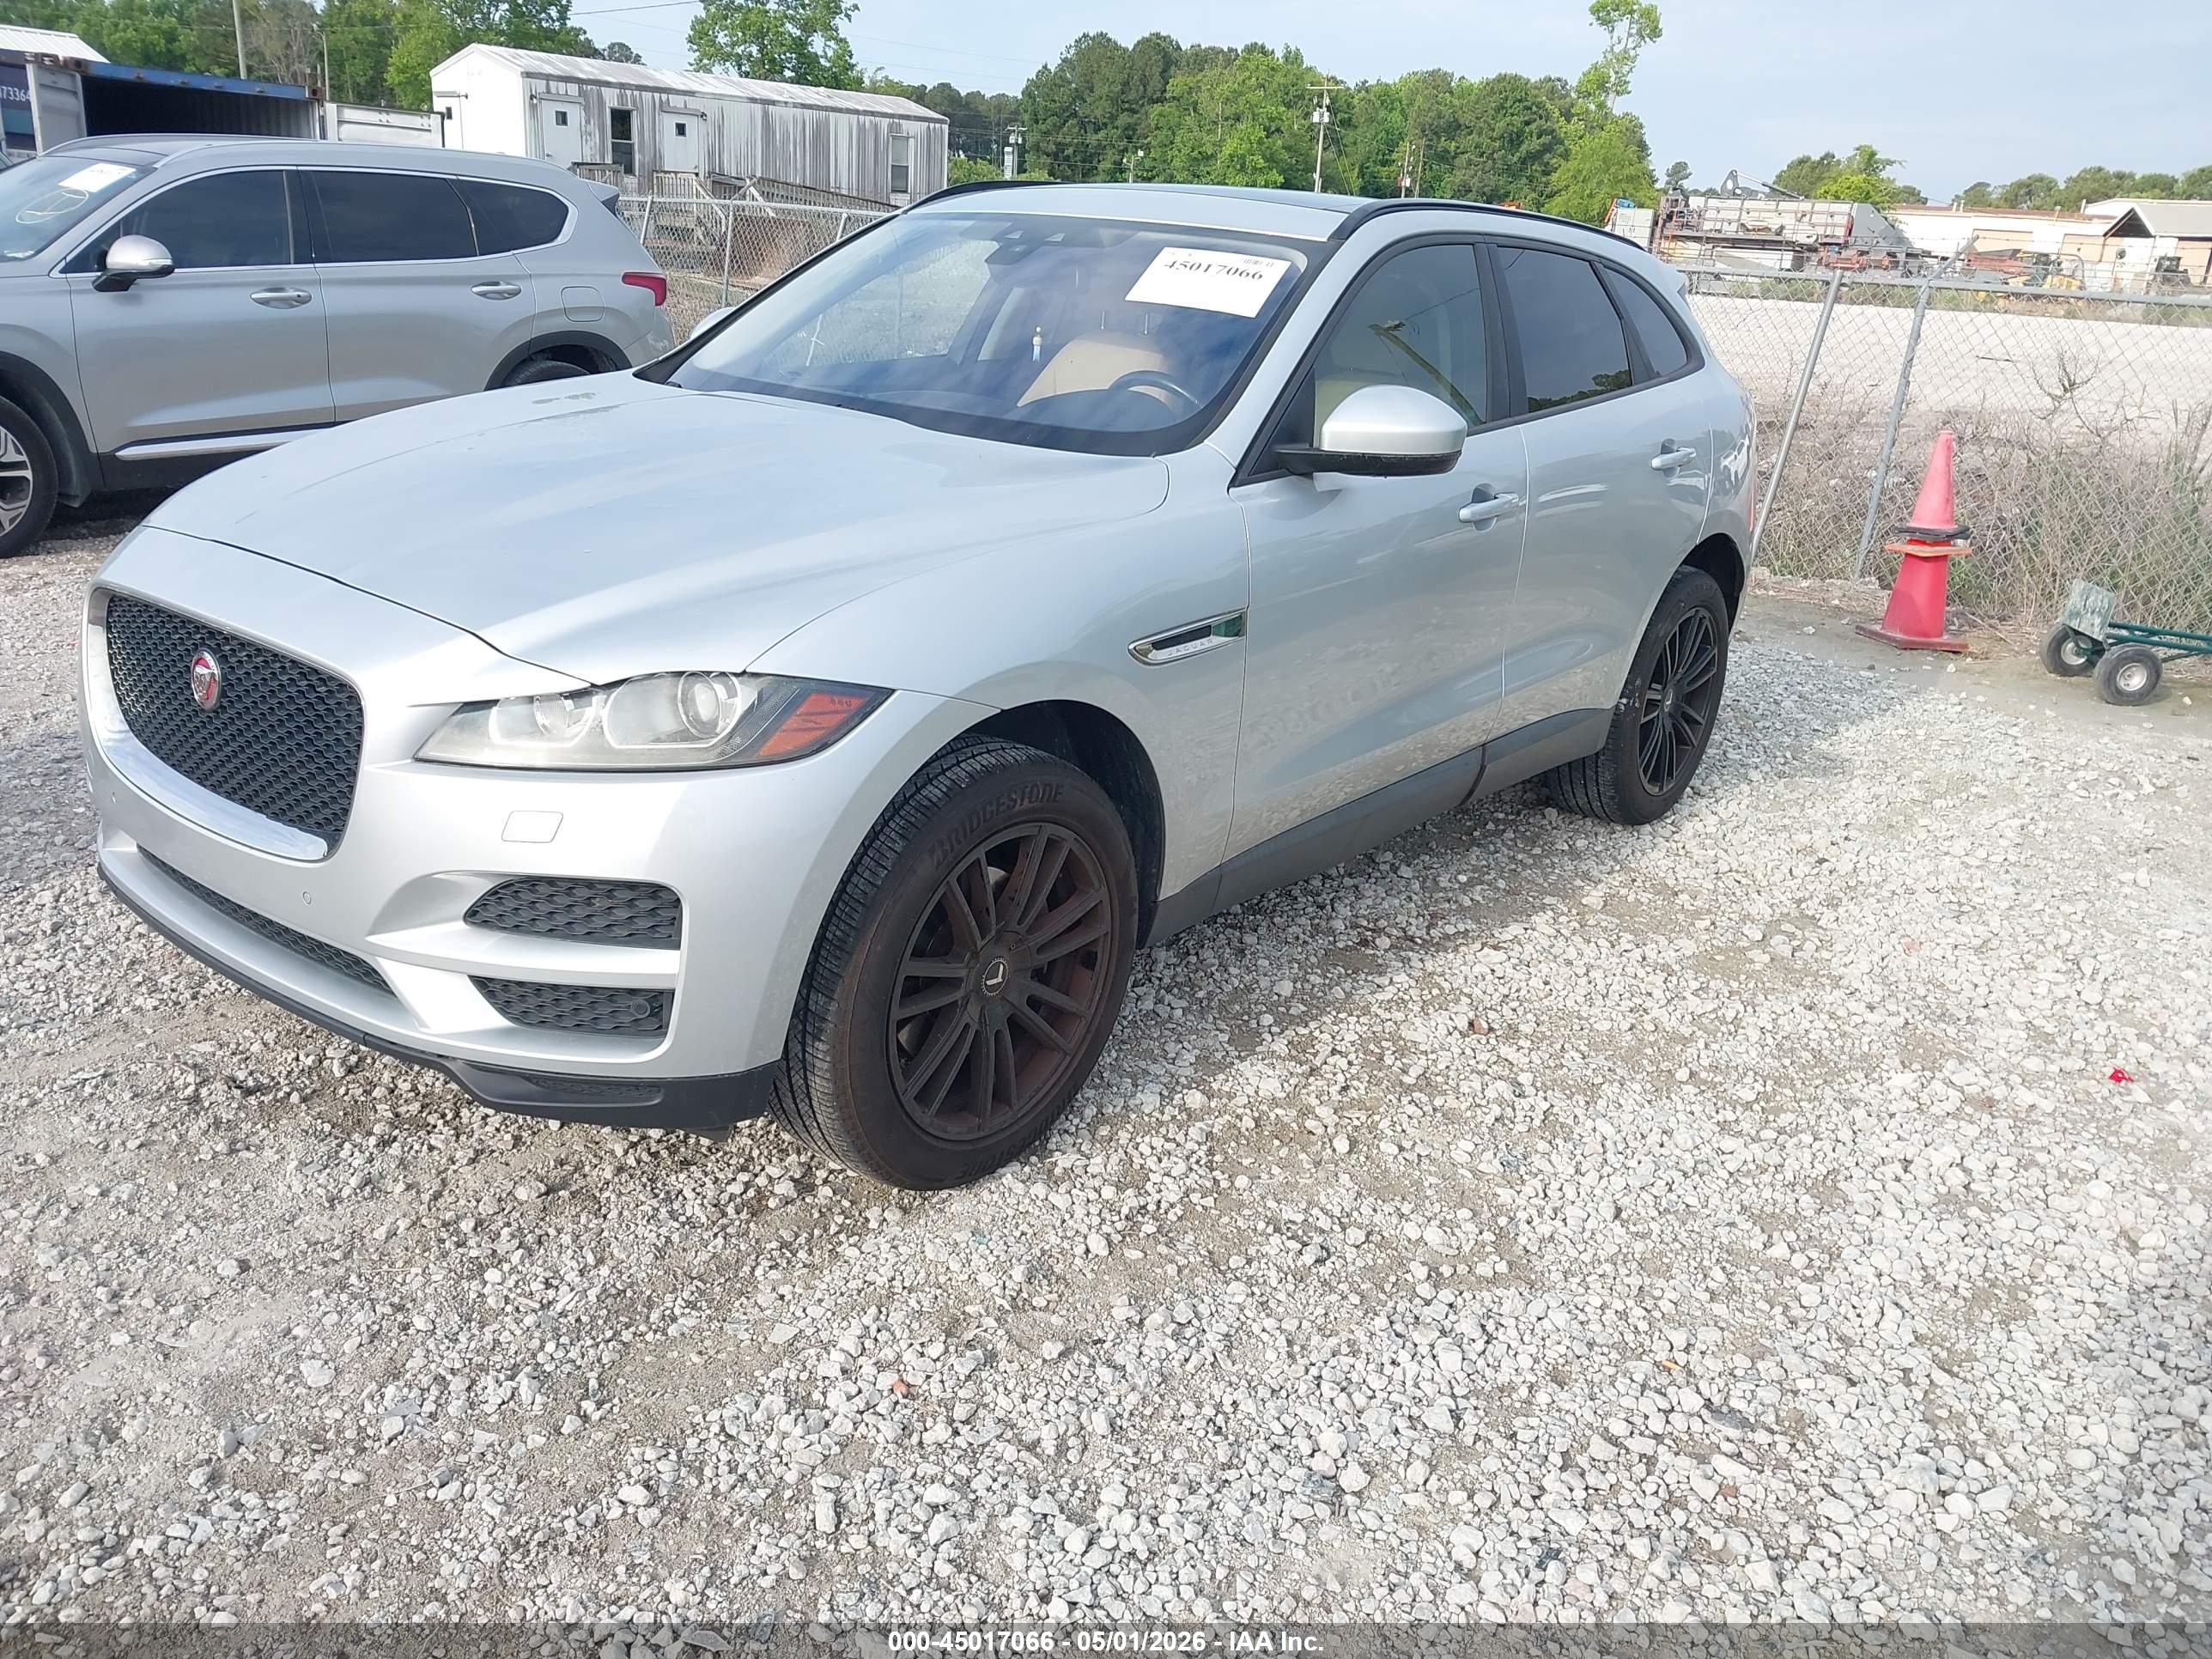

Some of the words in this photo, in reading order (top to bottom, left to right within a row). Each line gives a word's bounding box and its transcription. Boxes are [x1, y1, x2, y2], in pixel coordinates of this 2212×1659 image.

[1164, 259, 1263, 280] 45017066
[1168, 638, 1213, 656] JAGUAR
[927, 781, 1064, 872] BRIDGESTONE
